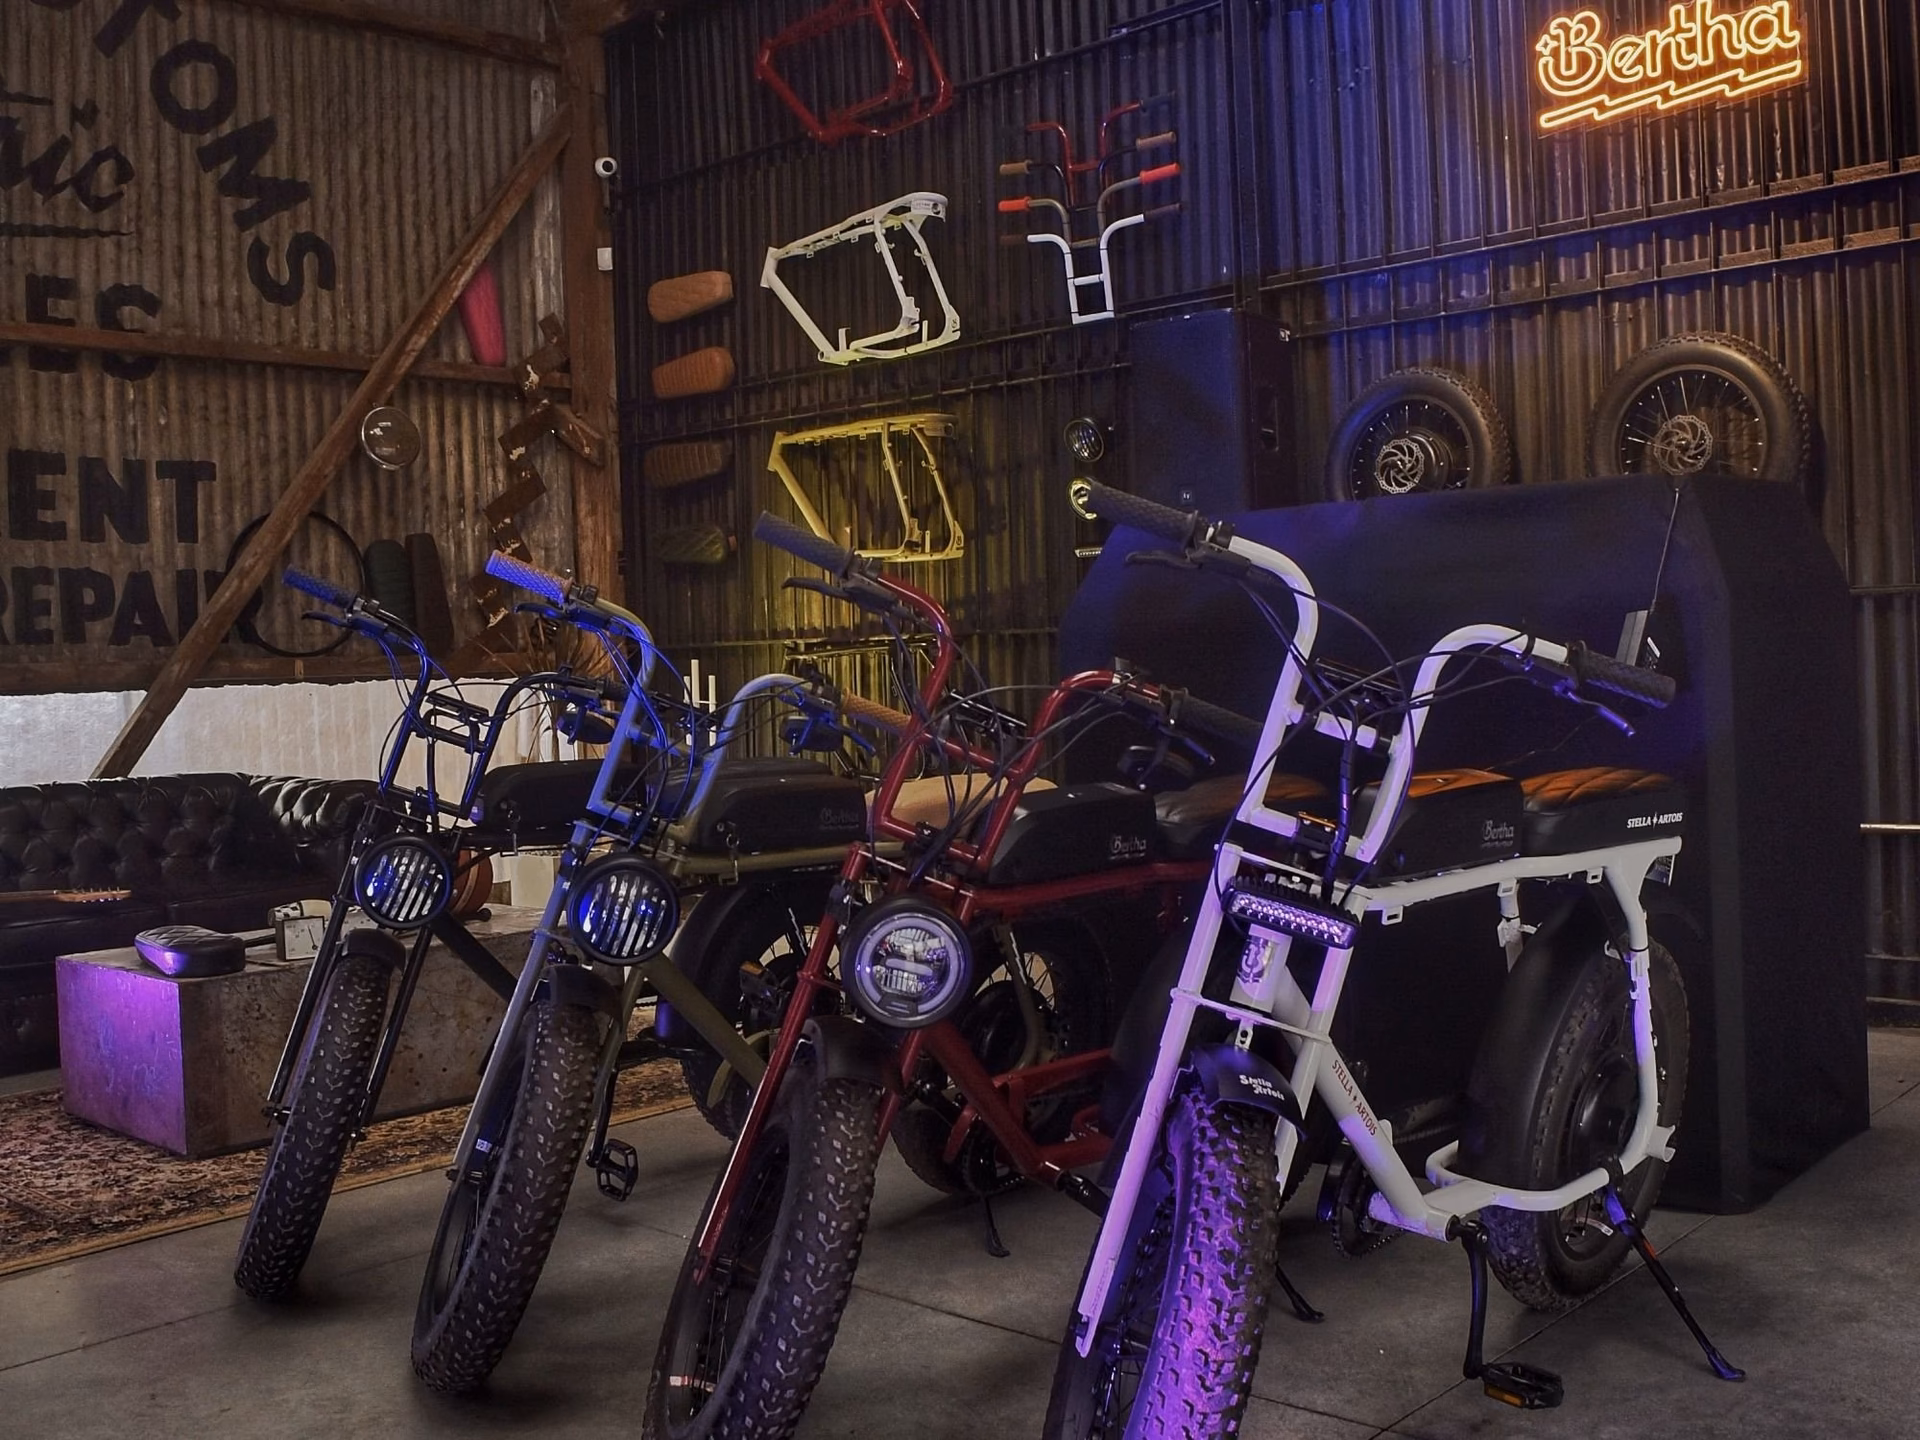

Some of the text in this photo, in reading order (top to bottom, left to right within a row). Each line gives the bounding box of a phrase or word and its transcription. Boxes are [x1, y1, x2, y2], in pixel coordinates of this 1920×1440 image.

[1537, 0, 1800, 96] Bertha
[1481, 820, 1514, 841] Bertha
[1626, 812, 1683, 829] STELLA ARTOIS
[1110, 835, 1147, 854] Bertha
[1239, 1074, 1273, 1088] Stella
[1332, 1059, 1378, 1136] STELLA ARTOIS
